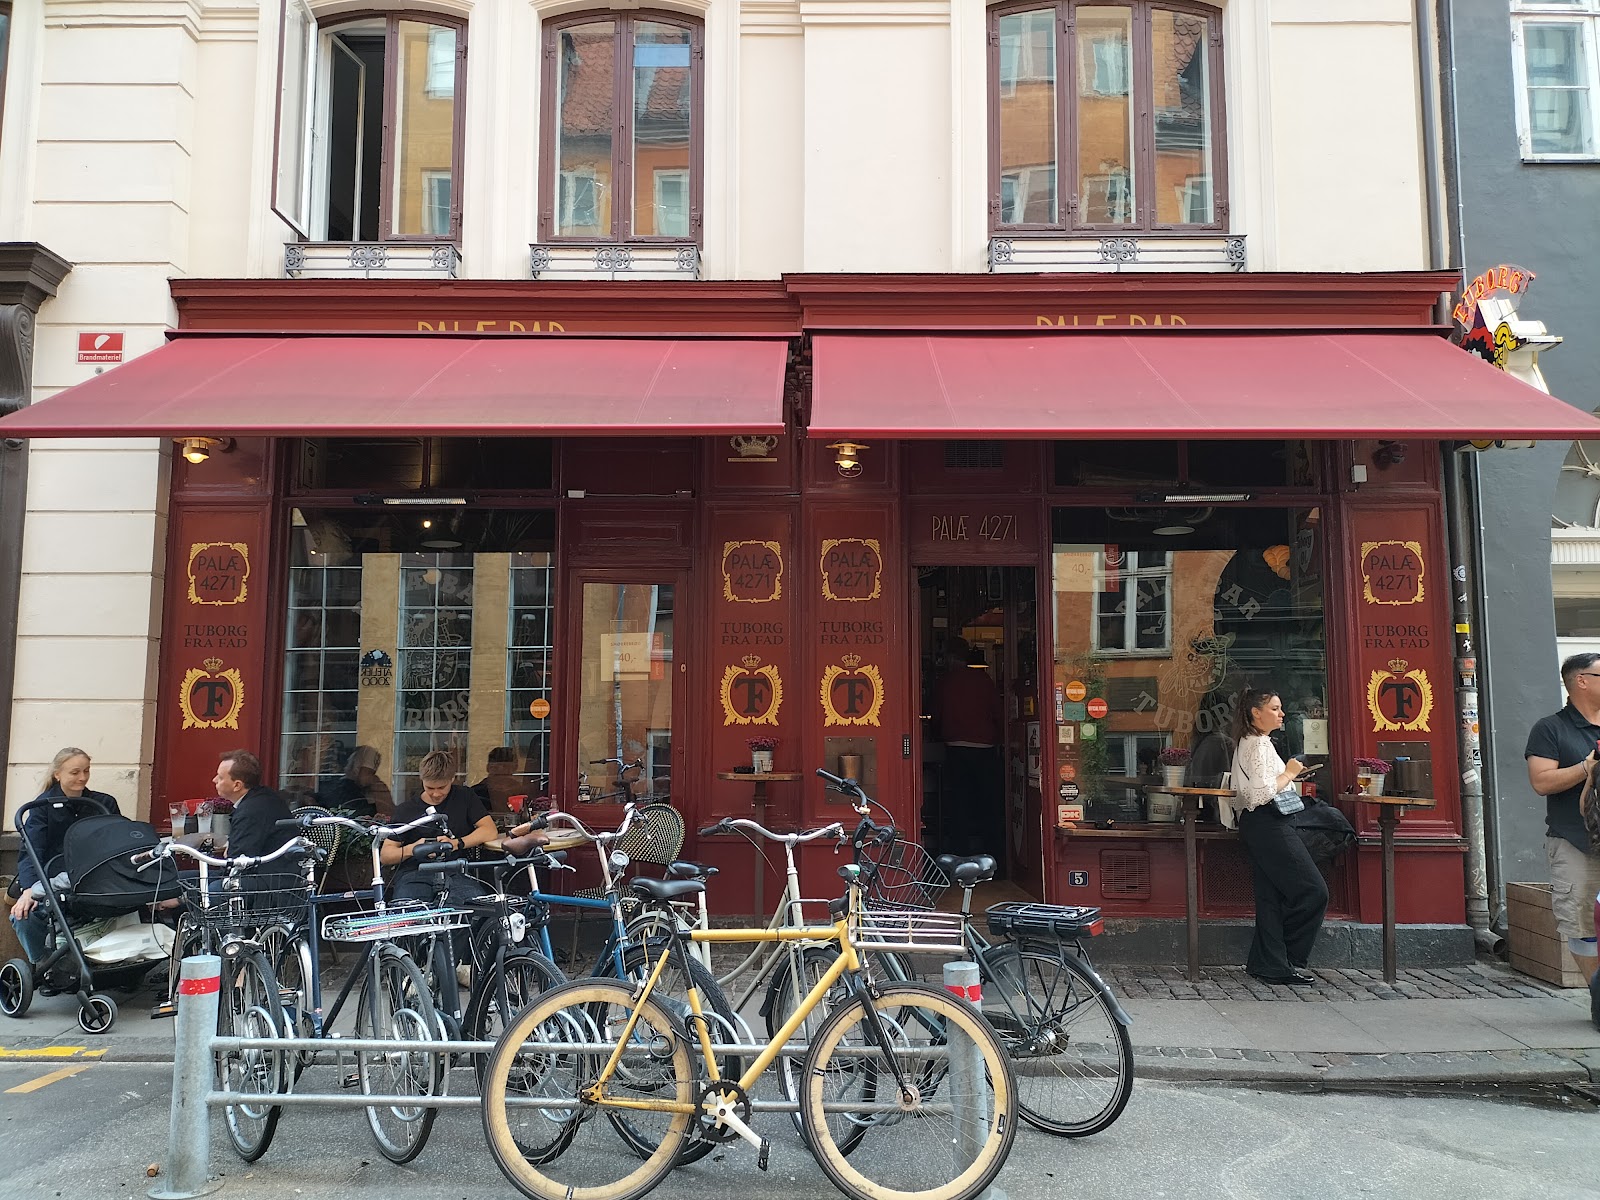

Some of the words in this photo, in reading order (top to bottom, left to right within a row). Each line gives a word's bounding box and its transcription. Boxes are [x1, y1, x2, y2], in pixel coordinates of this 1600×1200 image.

[1453, 266, 1522, 322] TUBORG
[932, 515, 970, 541] PALÆ
[979, 514, 1018, 541] 4271
[198, 556, 241, 571] PALÆ
[731, 554, 774, 570] PALÆ
[830, 552, 874, 567] PALÆ
[1371, 555, 1415, 570] PALÆ
[200, 575, 236, 590] 4271
[735, 573, 770, 589] 4271
[834, 571, 869, 587] 4271
[1376, 575, 1412, 590] 4271
[184, 624, 247, 637] TUBORG
[721, 622, 783, 634] TUBORG
[820, 621, 883, 633] TUBORG
[1363, 625, 1428, 637] TUBORG
[184, 638, 213, 648] FRA
[219, 638, 247, 648] FAD
[722, 635, 750, 645] FRA
[755, 635, 784, 645] FAD
[821, 634, 850, 645] FRA
[855, 634, 884, 645] FAD
[1365, 638, 1395, 648] FRA
[1400, 638, 1430, 648] FAD
[619, 652, 637, 663] 40,-
[1074, 872, 1084, 885] 5
